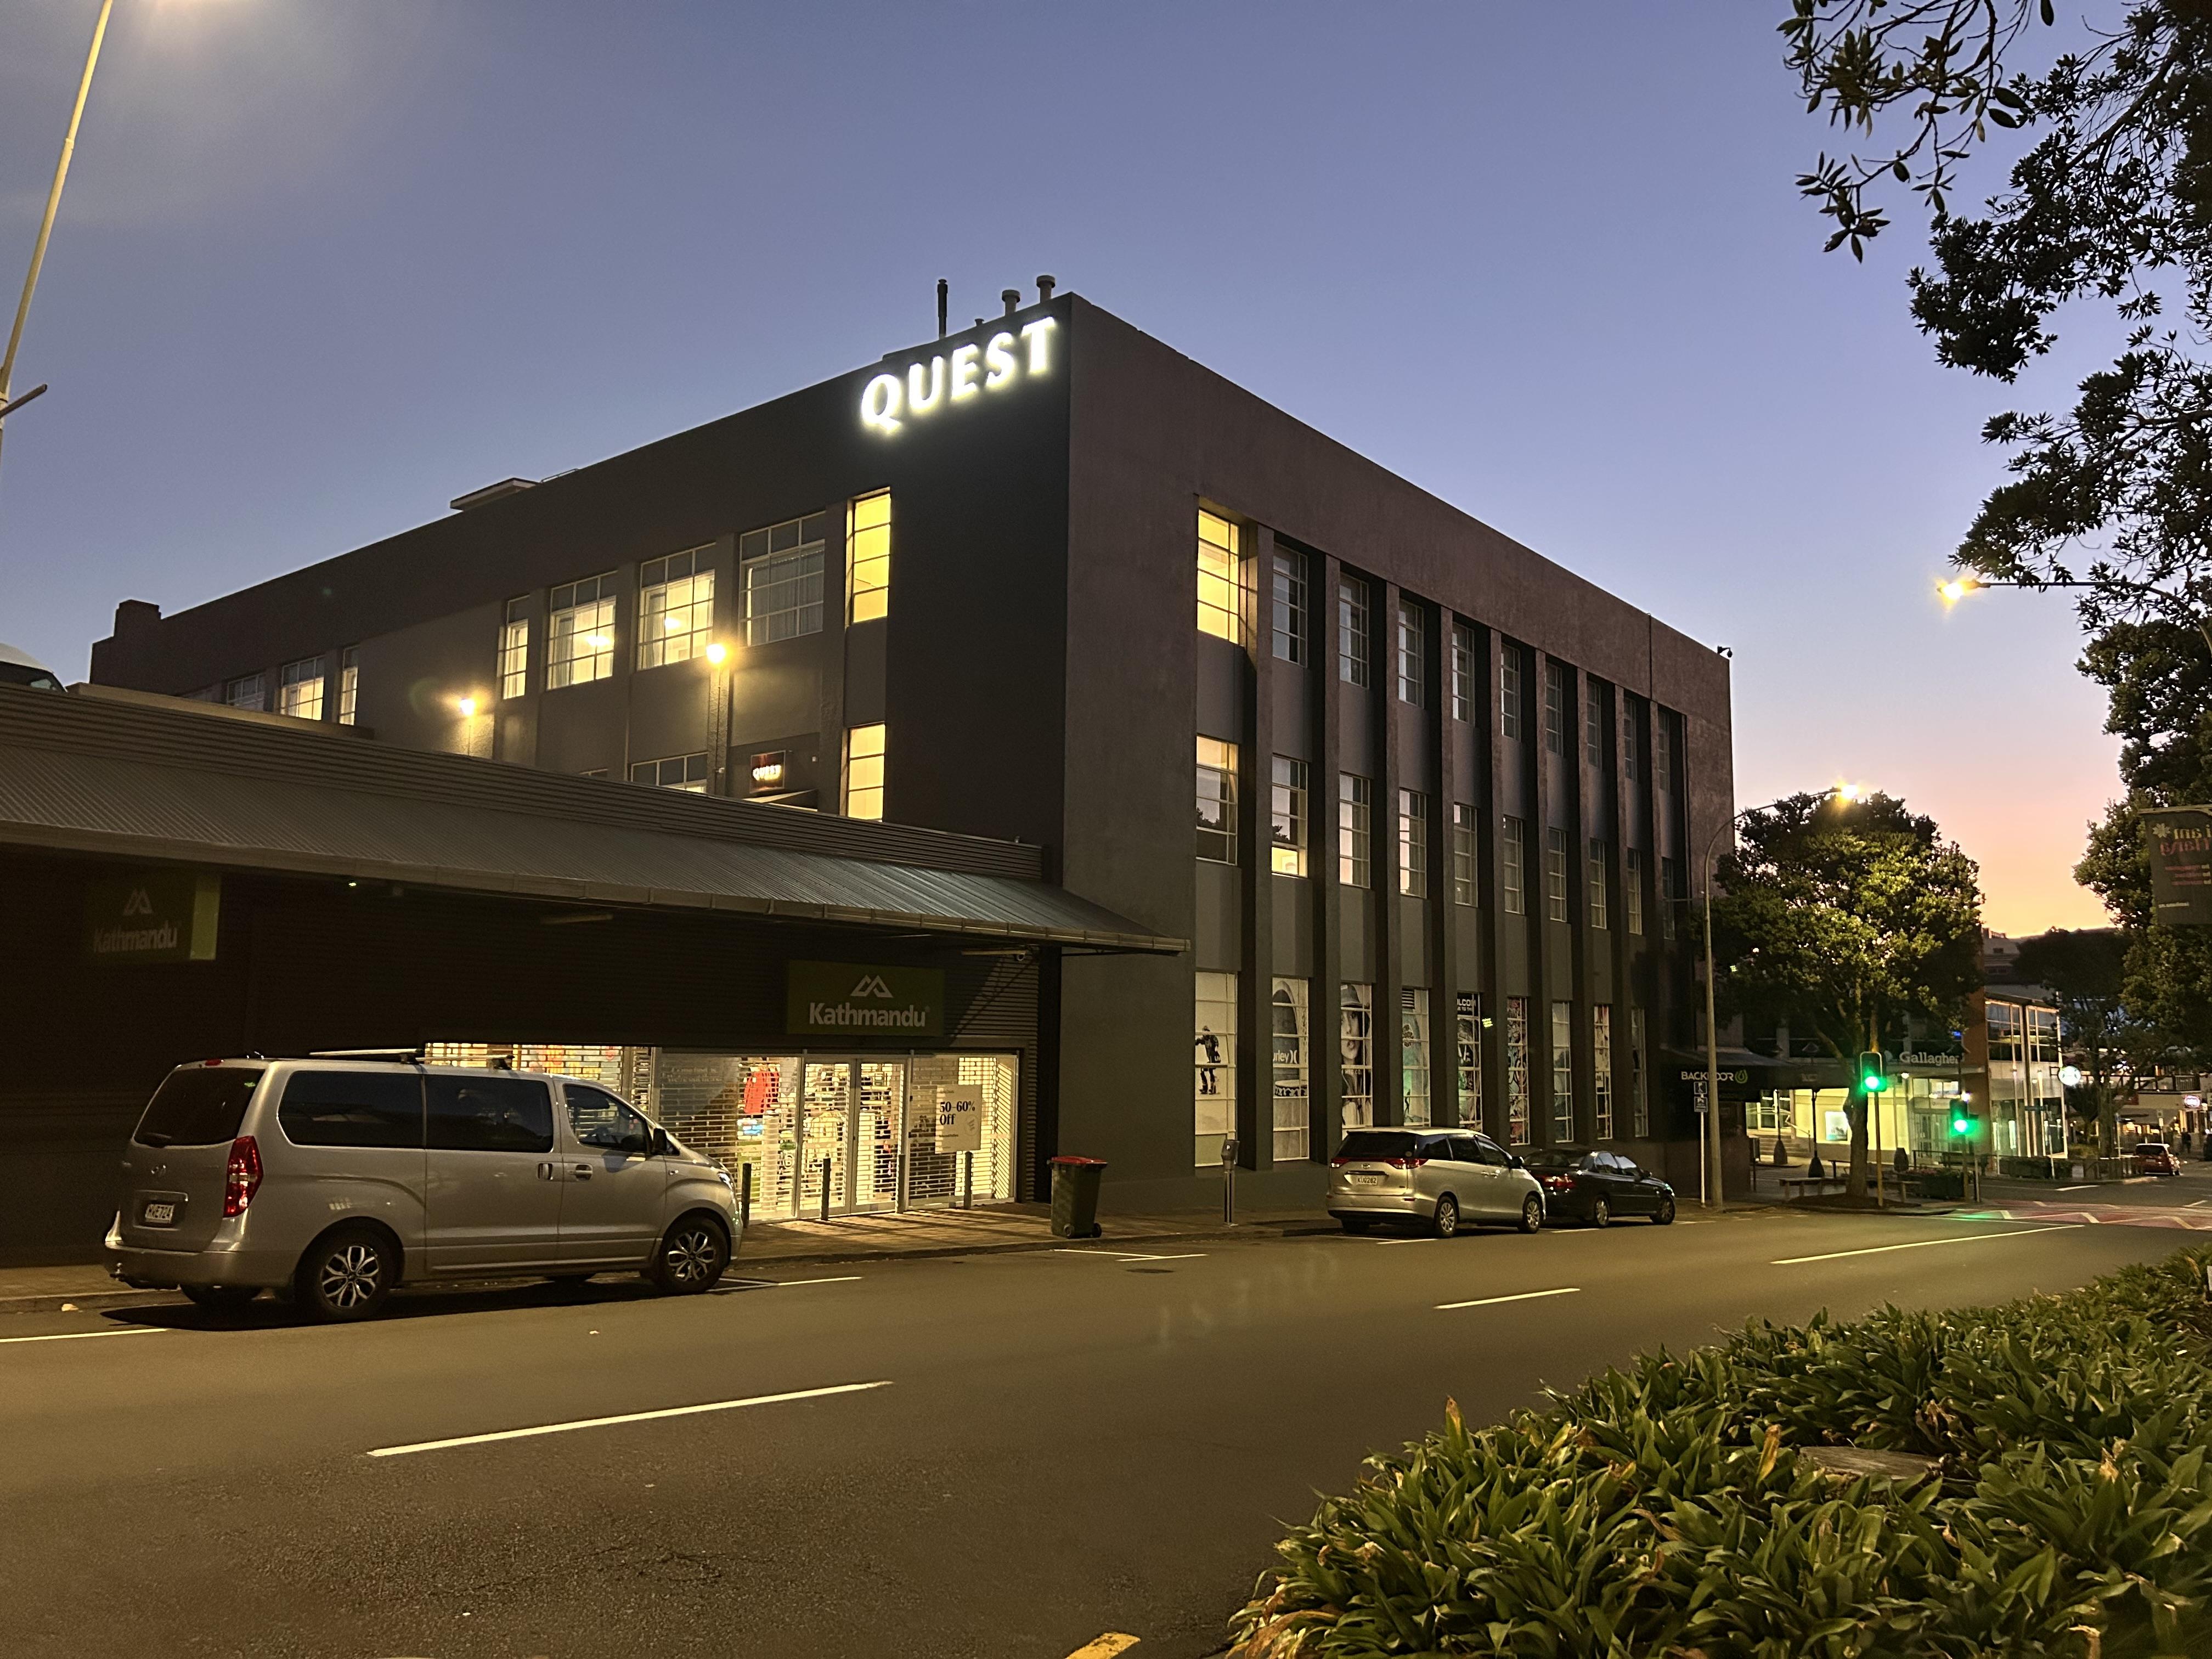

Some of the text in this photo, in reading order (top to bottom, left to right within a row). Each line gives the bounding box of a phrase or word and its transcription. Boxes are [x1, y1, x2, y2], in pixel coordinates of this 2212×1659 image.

[861, 315, 1056, 433] QUEST
[753, 765, 782, 780] QUEST
[94, 920, 177, 953] Kathmandu
[809, 1002, 926, 1028] Kathmandu
[1681, 1071, 1734, 1081] BACKOR
[940, 1114, 956, 1125] Off
